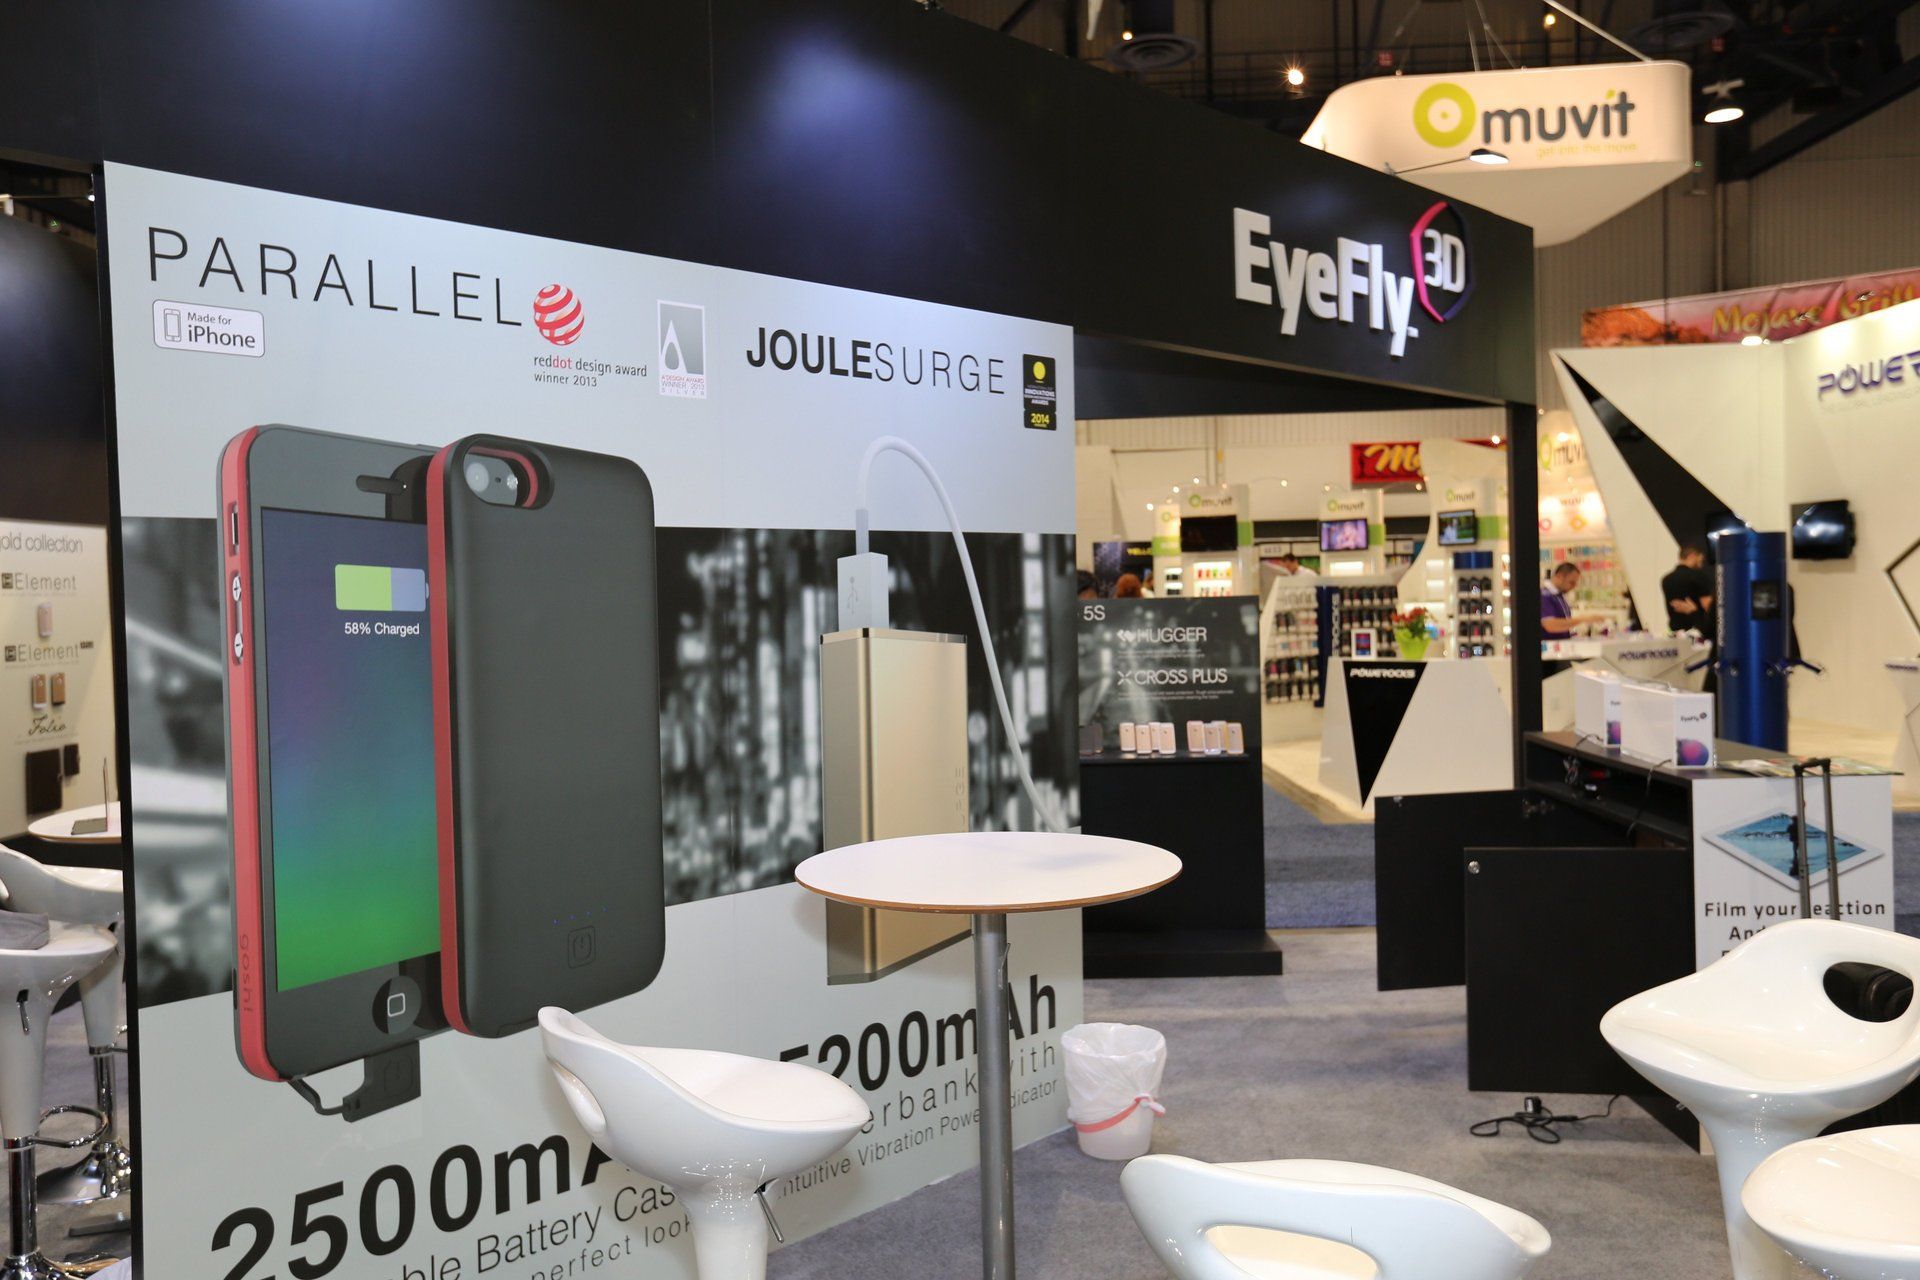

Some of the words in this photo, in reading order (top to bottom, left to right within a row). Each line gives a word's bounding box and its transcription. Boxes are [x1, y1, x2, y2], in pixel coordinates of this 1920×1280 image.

[1482, 90, 1636, 145] muvit
[148, 226, 522, 327] PARALLEL
[1233, 207, 1416, 357] EyeFly
[1423, 228, 1466, 294] 3D
[187, 312, 215, 325] Made
[216, 314, 232, 326] for
[187, 324, 256, 349] iPhone
[534, 355, 572, 370] reddot
[575, 358, 612, 377] design
[615, 365, 648, 377] award
[746, 326, 1005, 395] JOULESURGE
[534, 372, 568, 385] winner
[573, 375, 598, 387] 2013
[1031, 413, 1050, 424] 2014
[25, 533, 83, 553] collection
[15, 572, 77, 590] Element
[1083, 605, 1106, 621] 5S
[344, 622, 371, 635] 58%
[374, 622, 420, 638] Charged
[1136, 627, 1208, 643] HUGGER
[18, 643, 79, 662] Element
[1134, 669, 1188, 685] CROSS
[1192, 668, 1228, 684] PLUS
[1704, 902, 1746, 917] Film
[1754, 903, 1797, 919] your
[1813, 900, 1886, 916] eaction
[857, 1124, 934, 1169] Vibration
[940, 1107, 981, 1136] Powe
[477, 1204, 602, 1274] Battery
[613, 1184, 676, 1222] Cas
